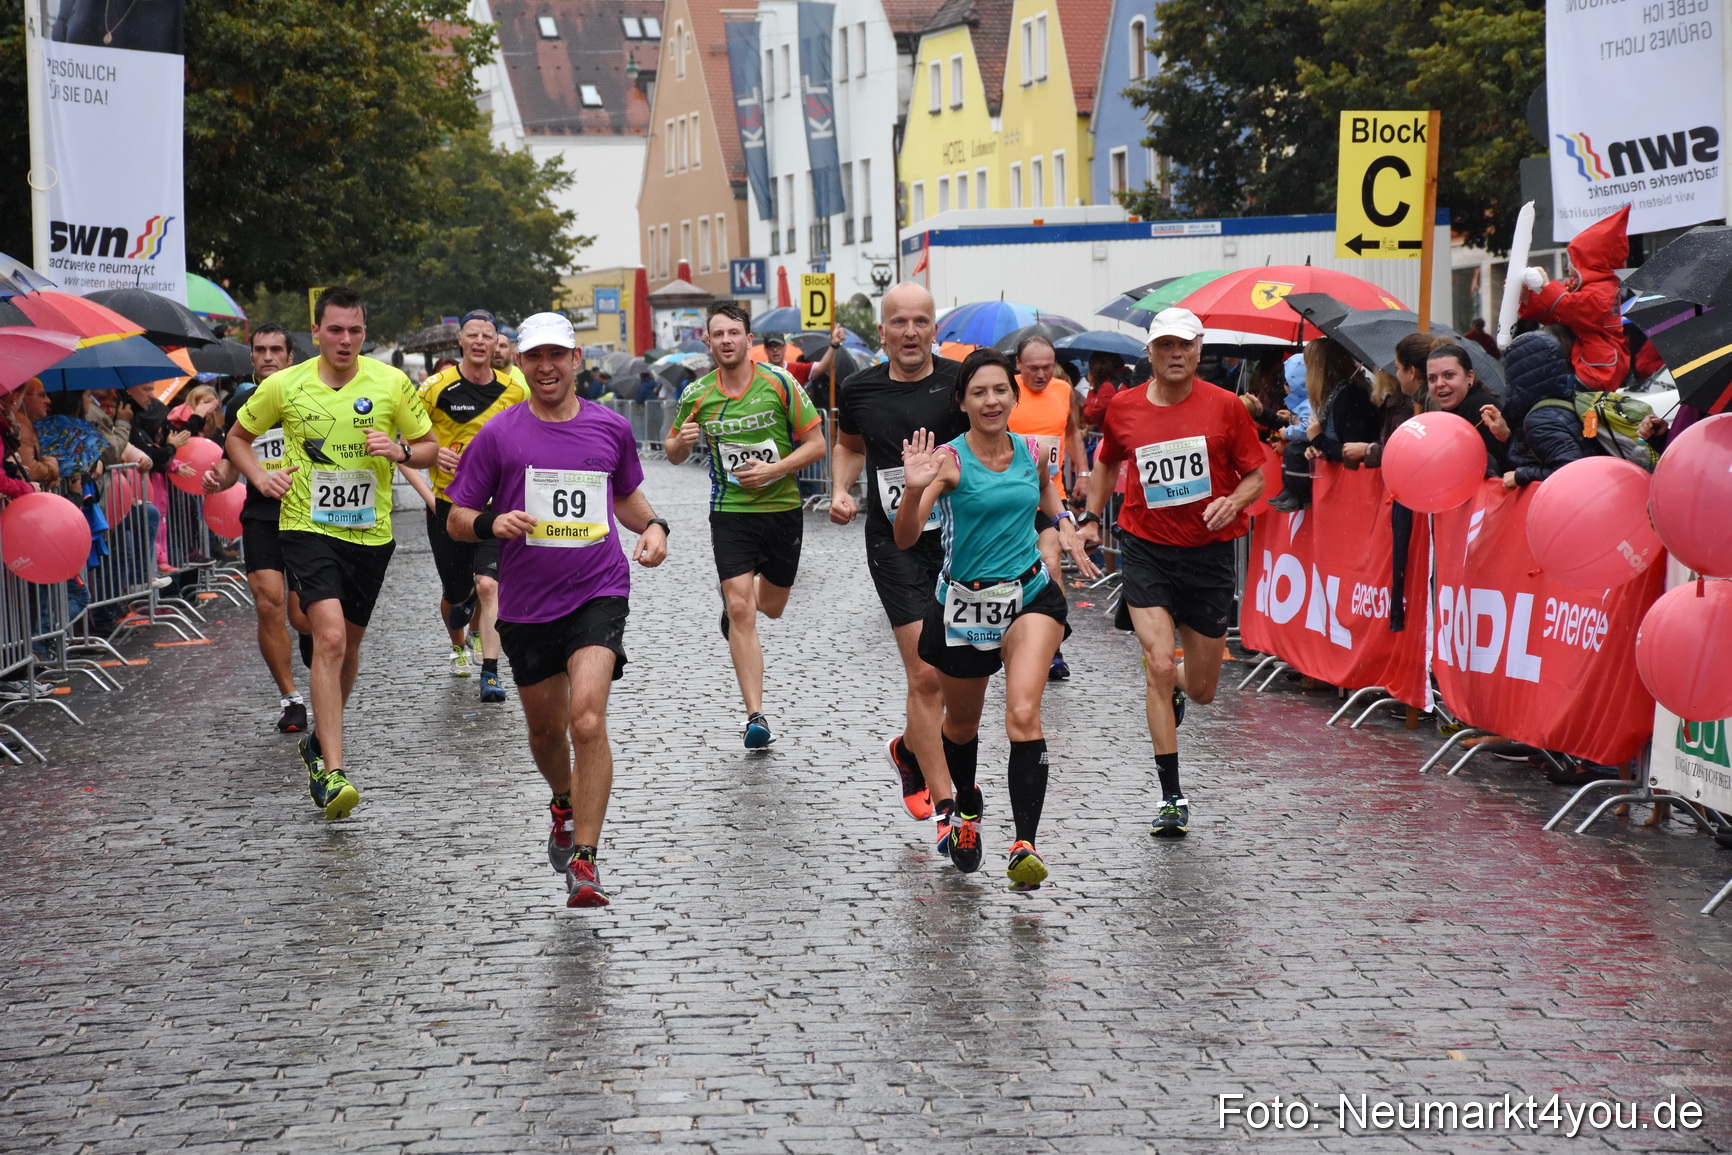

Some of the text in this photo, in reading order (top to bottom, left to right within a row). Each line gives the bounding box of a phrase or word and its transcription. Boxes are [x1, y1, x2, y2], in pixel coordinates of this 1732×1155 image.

[63, 85, 80, 103] SIE
[84, 87, 108, 105] DA!
[1352, 117, 1427, 143] Block
[942, 140, 965, 166] HOTEL
[1362, 155, 1412, 227] C
[50, 220, 128, 258] swn
[98, 262, 156, 276] neumarkt
[63, 276, 79, 287] wir
[107, 279, 176, 292] lebenqualität!
[804, 275, 831, 286] Block
[810, 290, 827, 317] D
[705, 409, 777, 436] BOCK
[260, 440, 284, 458] 18
[332, 443, 347, 451] THE
[340, 451, 353, 459] 100
[563, 472, 602, 485] BOCK
[1145, 452, 1204, 484] 2078
[318, 483, 371, 508] 2847
[888, 484, 906, 511] 2
[1166, 485, 1190, 498] Erich
[552, 489, 586, 518] 69
[546, 524, 588, 537] Gerhard
[953, 598, 1017, 624] 2134
[967, 630, 1001, 642] Sandra
